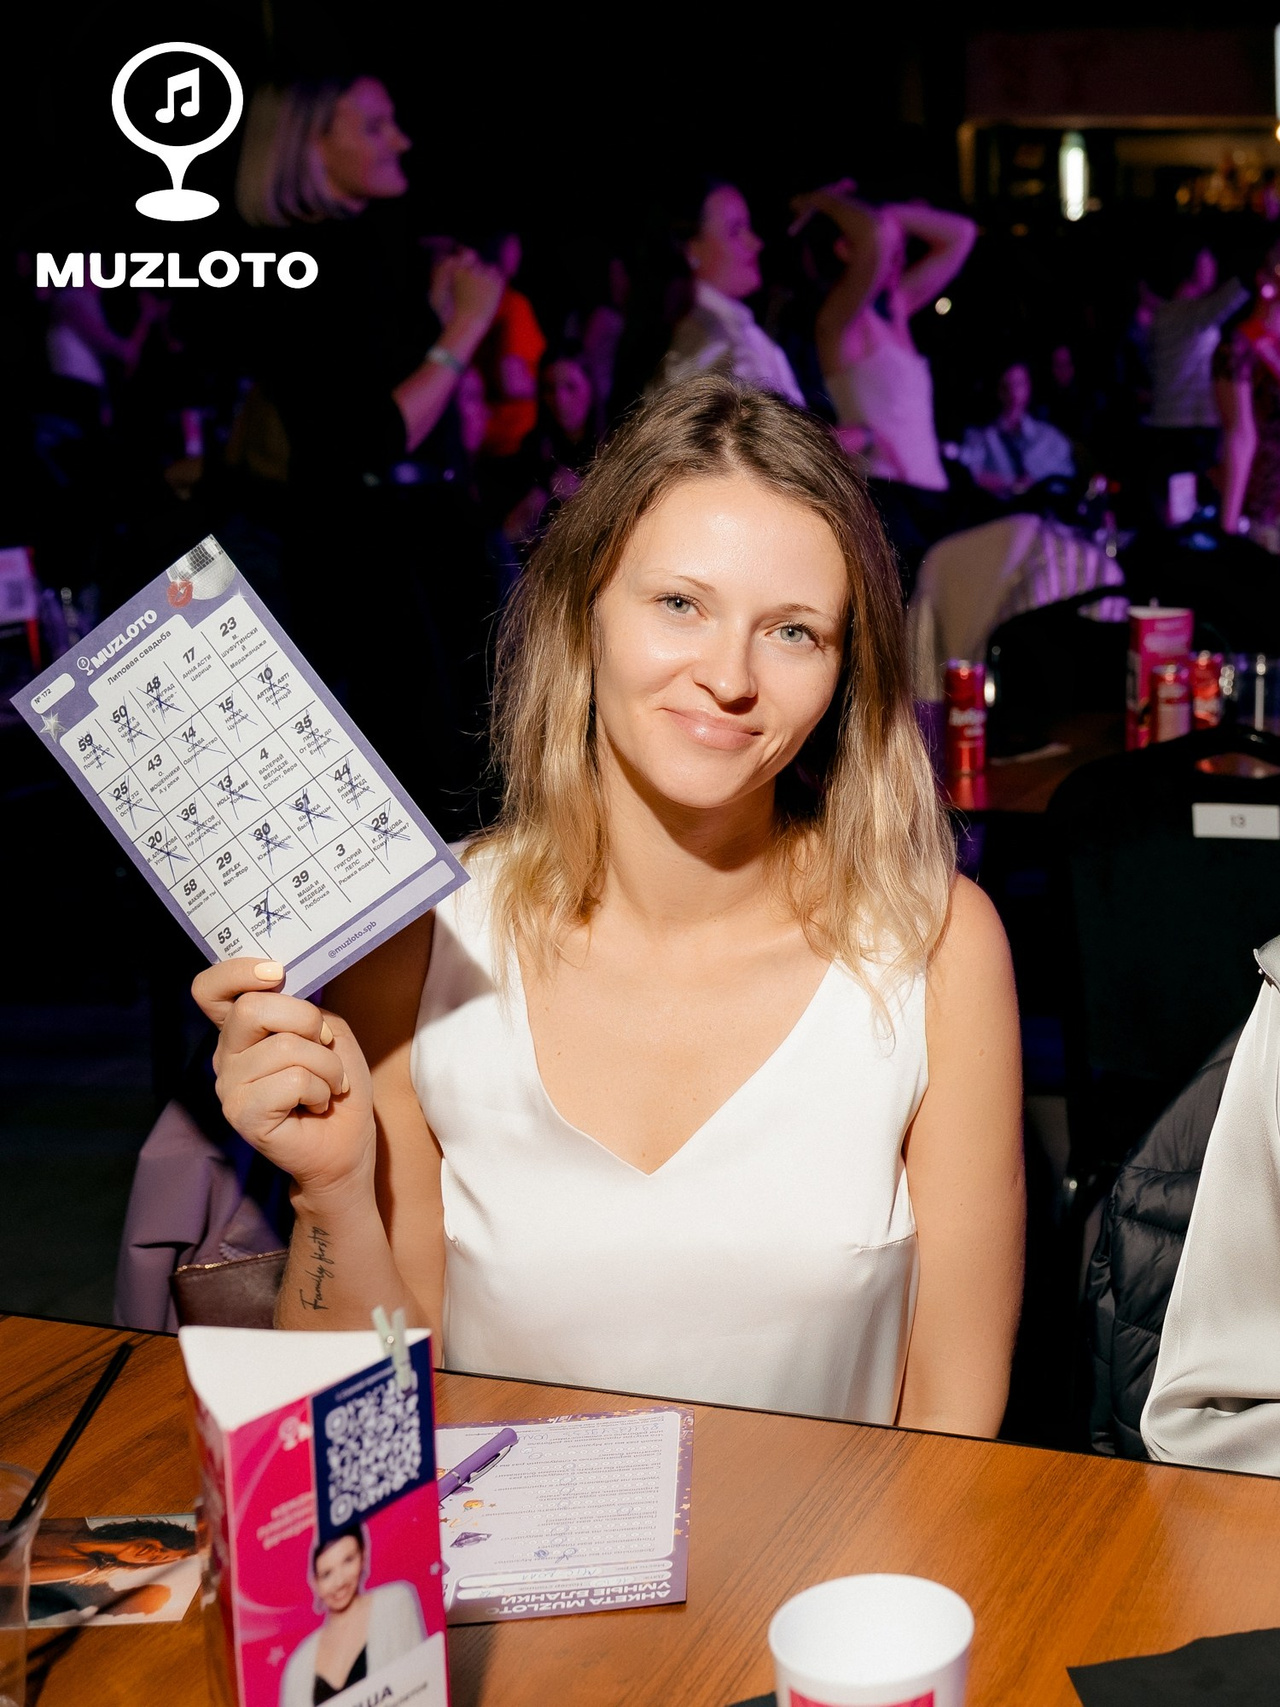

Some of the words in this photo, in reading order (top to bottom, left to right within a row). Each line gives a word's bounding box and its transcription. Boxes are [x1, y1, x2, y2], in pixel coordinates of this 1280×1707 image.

[219, 616, 237, 637] 23
[89, 609, 158, 669] MUZLOTO
[106, 656, 140, 686] Липовая
[138, 630, 172, 659] свадьба
[182, 646, 195, 664] 17
[181, 664, 198, 680] АННА
[196, 653, 212, 668] АСТИ
[256, 666, 273, 684] 10
[145, 682, 176, 709] ЛЕНГРАД
[146, 675, 161, 697] 48
[111, 704, 128, 724] 50
[217, 695, 234, 714] 15
[116, 715, 136, 733] СЕРГА
[181, 725, 197, 743] 14
[293, 713, 313, 735] 35
[77, 732, 94, 752] 59
[147, 753, 162, 772] 43
[259, 747, 269, 760] 4
[257, 752, 285, 776] ВАЛЕРИЙ
[262, 759, 289, 781] МЕЛАДЗЕ
[333, 762, 351, 782] 44
[148, 764, 181, 793] МОШЕННИКИ
[216, 773, 233, 792] 13
[111, 780, 129, 801] 25
[179, 802, 197, 822] 36
[294, 792, 311, 812] 51
[252, 821, 271, 842] 30
[370, 811, 389, 832] 28
[146, 830, 163, 850] 20
[335, 843, 346, 857] 3
[215, 850, 232, 871] 29
[332, 847, 363, 872] ГРИГОРИЙ
[343, 858, 361, 873] ЛЕПС
[221, 861, 242, 879] REFLEX
[291, 869, 310, 889] 39
[183, 878, 198, 897] 58
[296, 883, 315, 898] МАША
[298, 883, 326, 905] МЕДВЕДИ
[252, 897, 269, 918] 27
[303, 889, 331, 911] Любочка
[217, 926, 232, 945] 53
[327, 920, 377, 959] @muzloto.spb
[300, 1265, 335, 1310] Family
[501, 1588, 589, 1605] БЛАНКИ
[592, 1589, 671, 1606] АНКЕТА
[593, 1581, 671, 1597] УМНЫЕ
